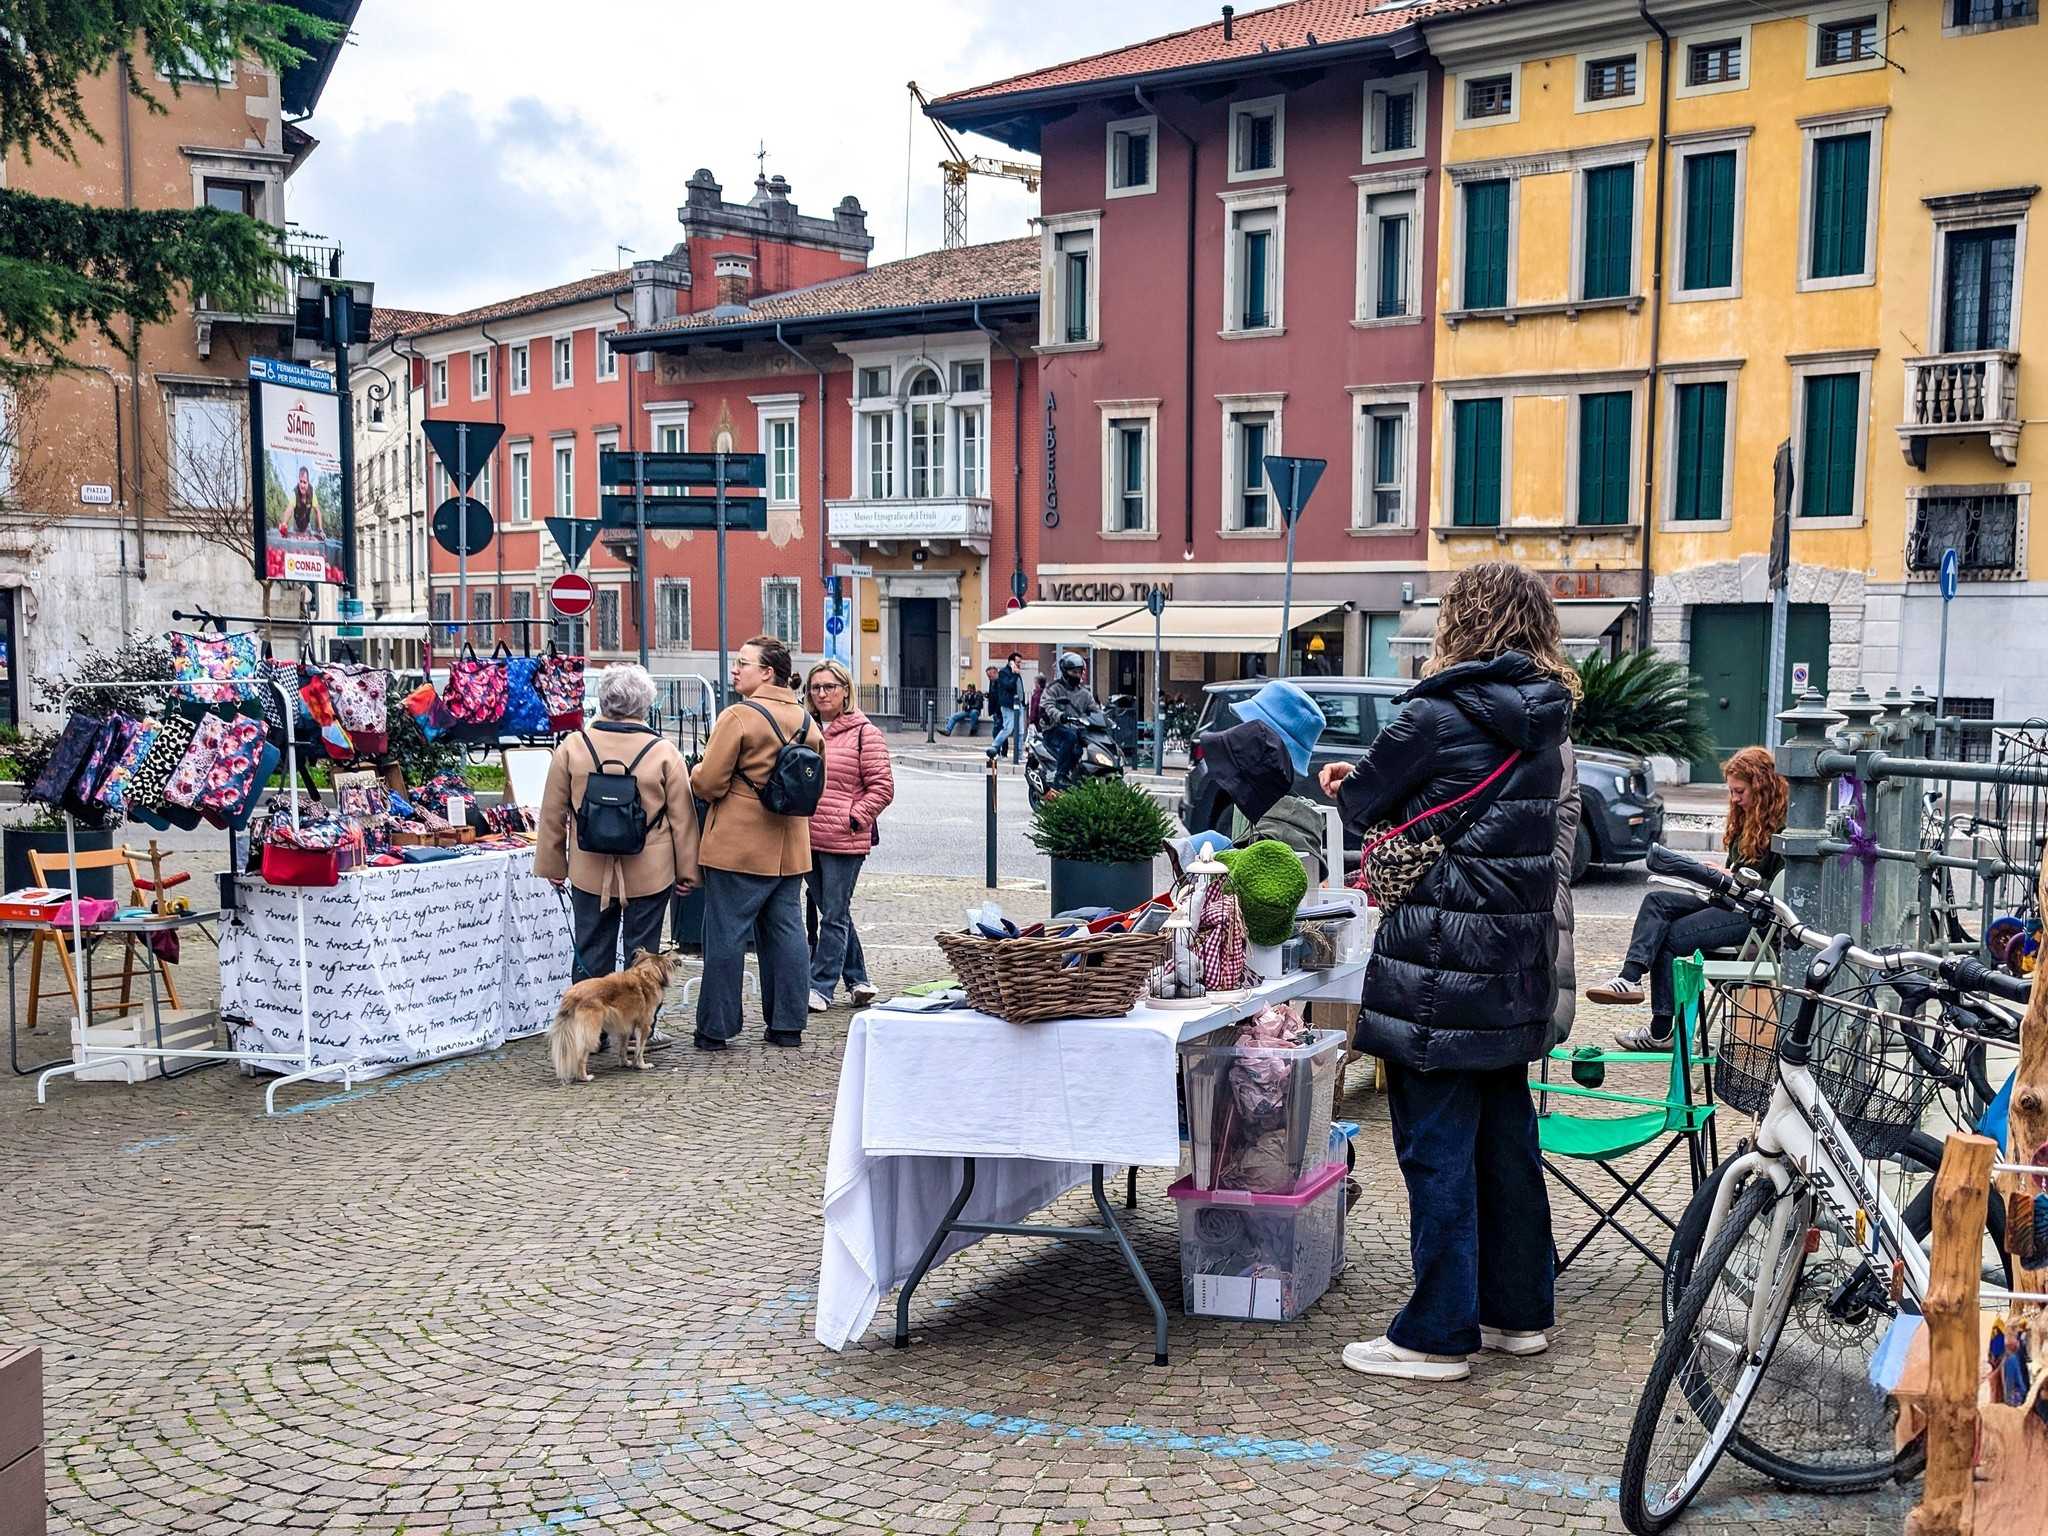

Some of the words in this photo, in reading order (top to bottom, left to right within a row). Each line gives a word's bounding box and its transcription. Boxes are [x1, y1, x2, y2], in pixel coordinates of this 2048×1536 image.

[277, 363, 300, 374] FERMATA
[301, 367, 330, 379] ATTREZZATA
[277, 374, 289, 383] PER
[289, 376, 310, 386] DISABILI
[311, 379, 330, 390] MOTORI
[1045, 391, 1059, 529] ALBERGO
[854, 511, 873, 521] Museo
[919, 510, 937, 520] Friuli
[295, 560, 322, 572] CONAD
[1053, 582, 1125, 601] VECCHIO
[291, 891, 313, 902] zro
[265, 907, 299, 923] twelv
[263, 933, 295, 945] seven
[303, 940, 321, 949] ne
[288, 957, 313, 969] zeo
[273, 977, 303, 1003] thirt
[312, 984, 335, 995] one
[254, 998, 304, 1016] seventee
[312, 1007, 353, 1029] eight
[271, 1027, 290, 1040] one
[297, 1029, 351, 1048] hndred
[1810, 1166, 1894, 1292] Bottechi
